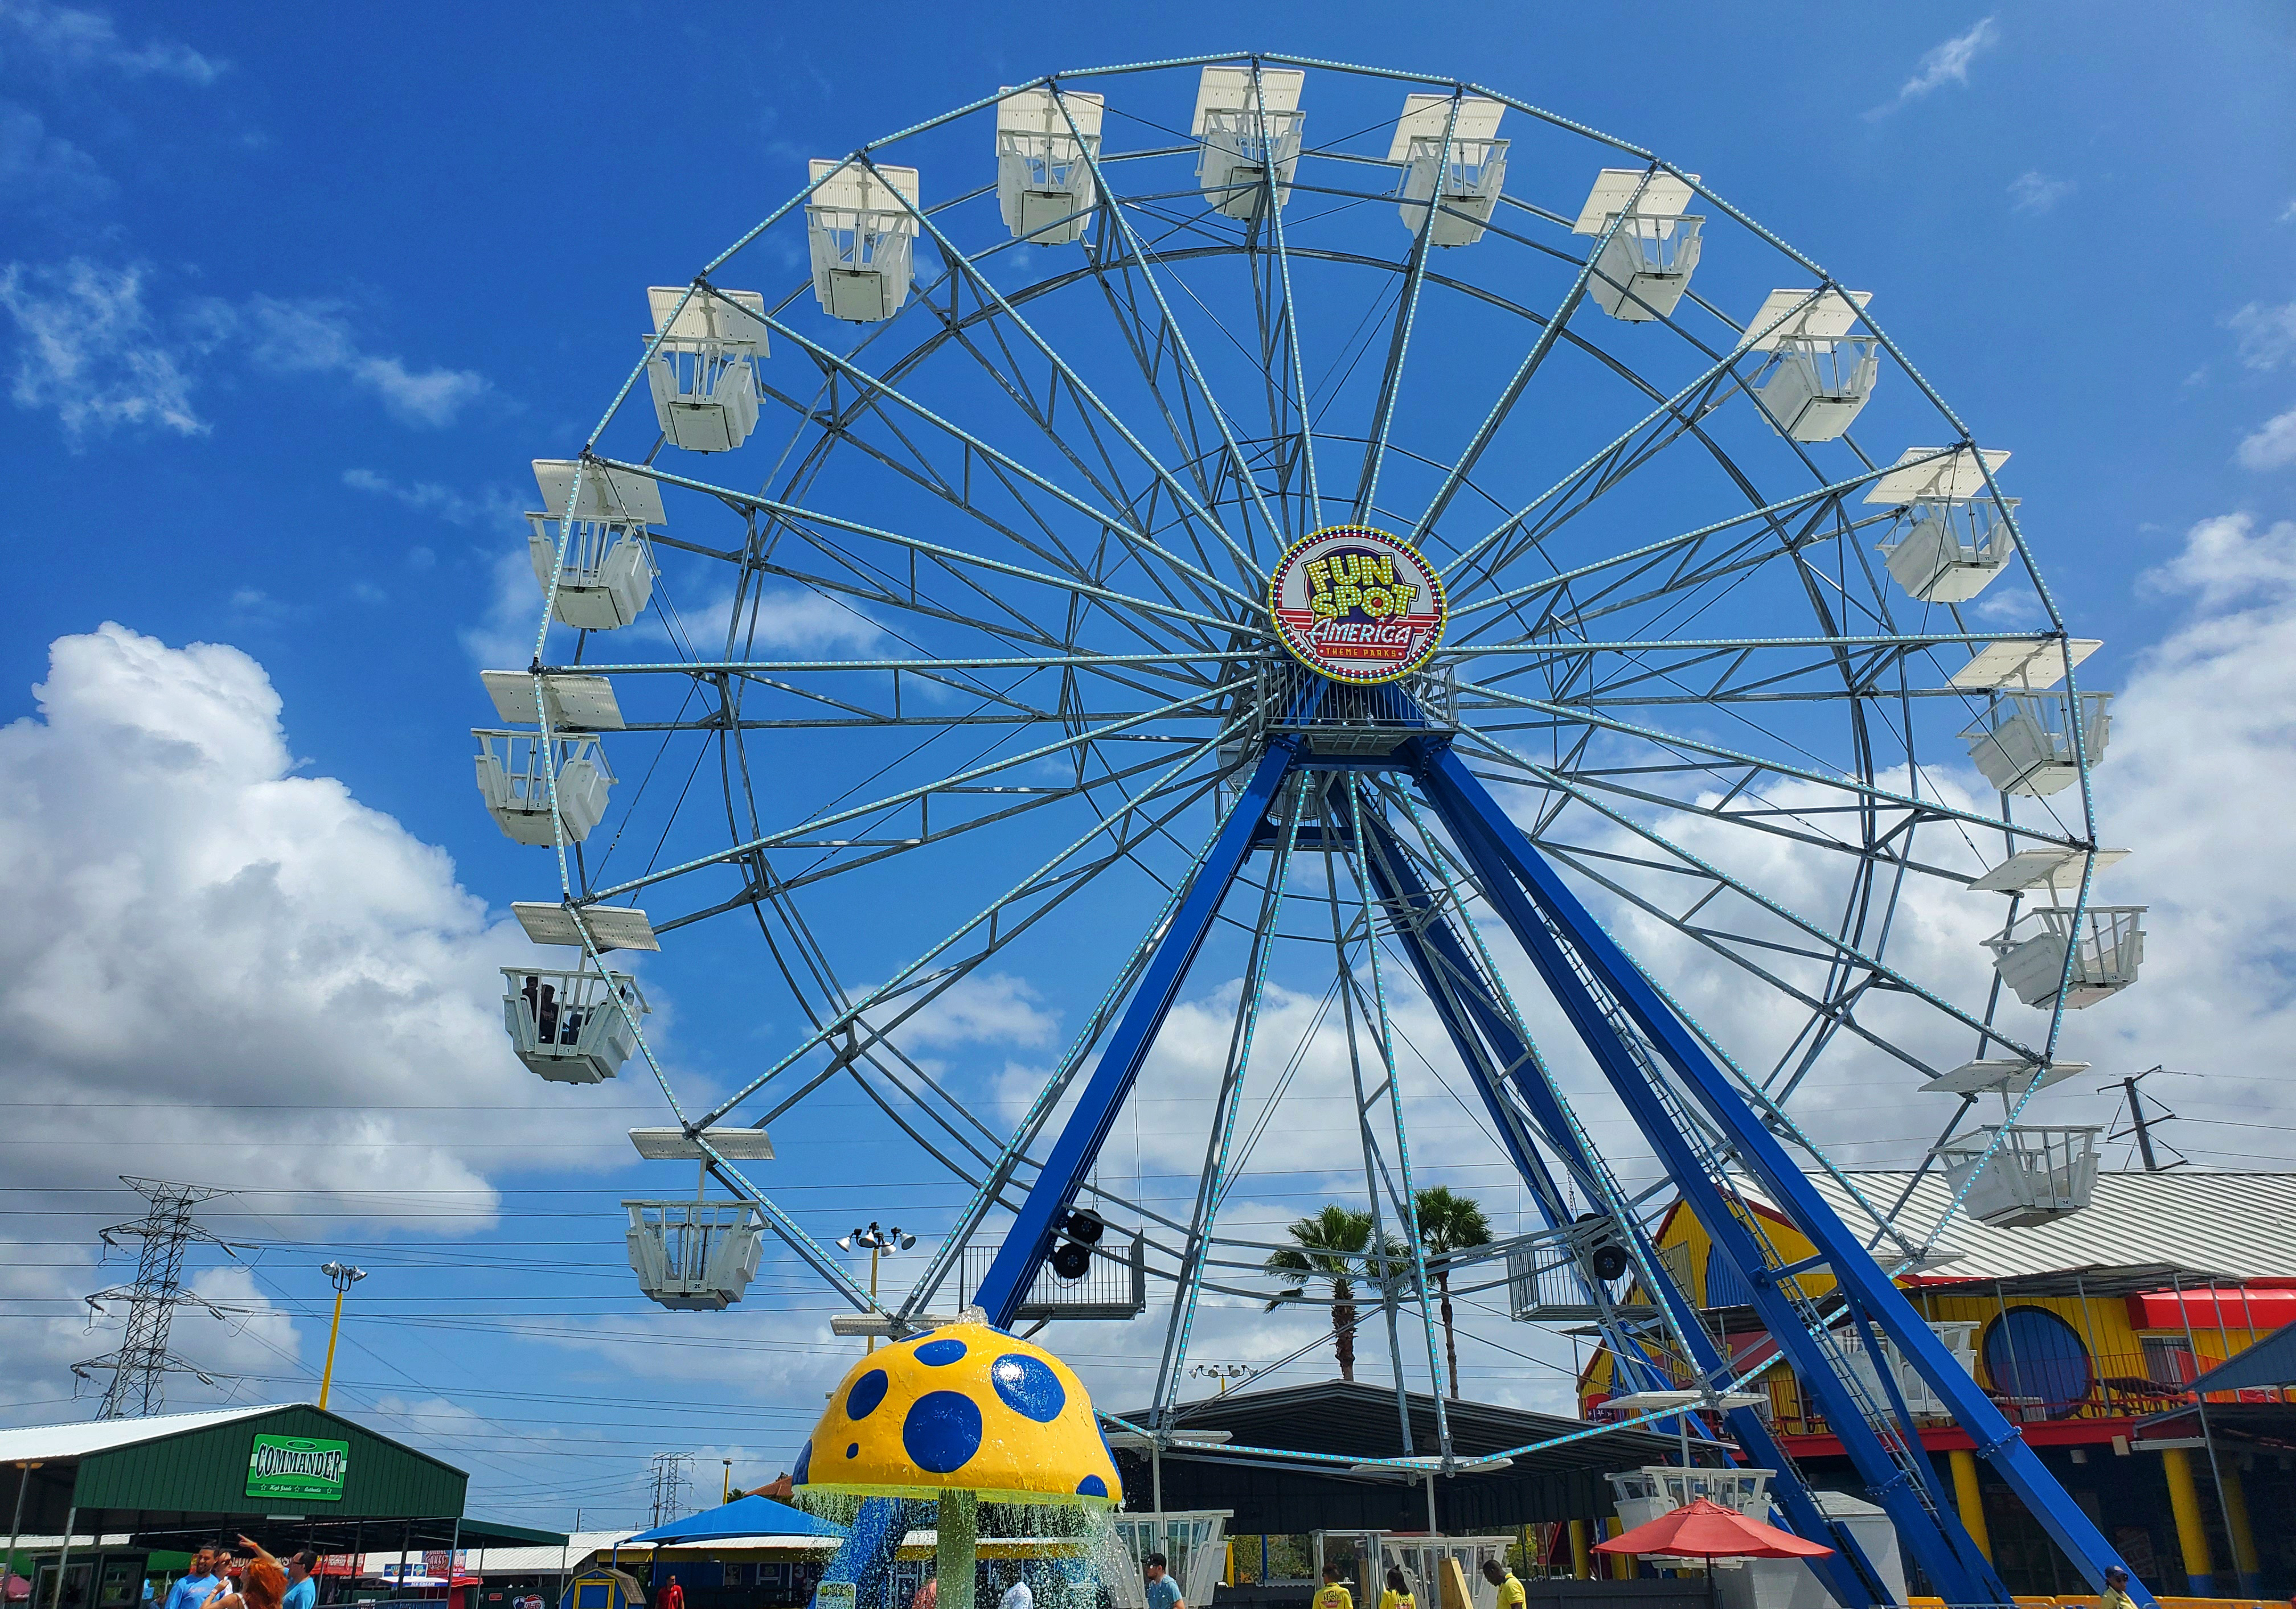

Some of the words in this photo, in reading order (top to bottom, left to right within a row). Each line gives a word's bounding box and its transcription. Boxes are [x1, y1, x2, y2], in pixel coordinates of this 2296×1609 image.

[1305, 553, 1394, 593] FUN
[1311, 583, 1417, 621] SPOT
[1306, 618, 1412, 644] AMERICA
[1326, 647, 1358, 656] THEME
[1363, 648, 1396, 657] PARKS
[256, 1443, 342, 1483] COMMANDER
[425, 1555, 446, 1565] CAKES
